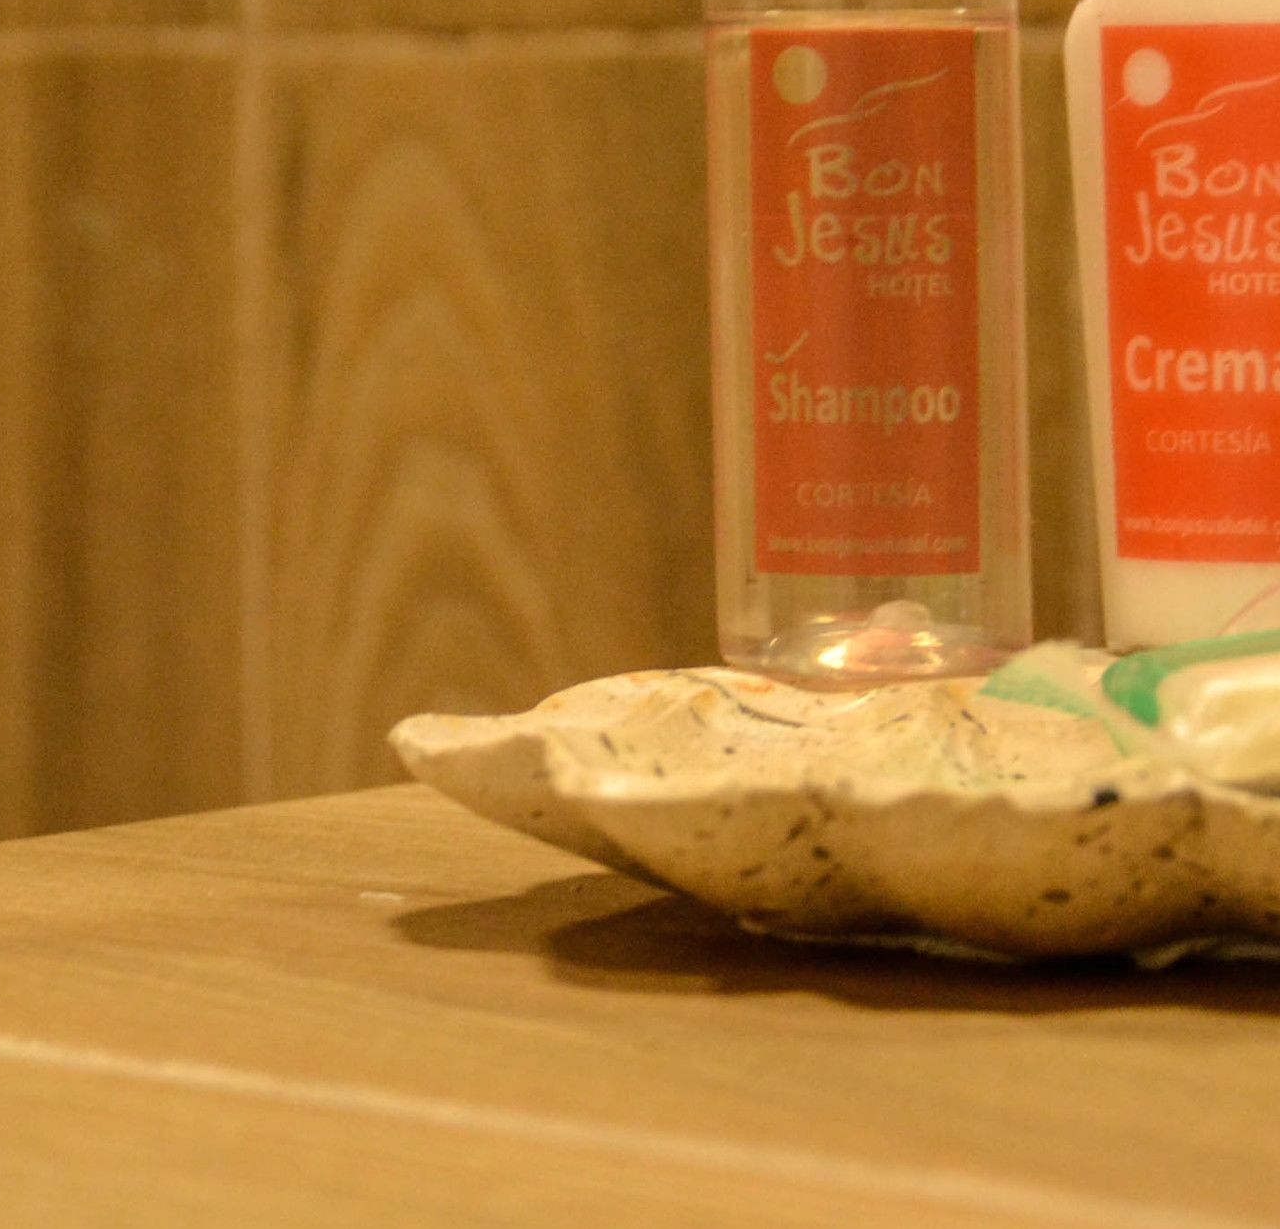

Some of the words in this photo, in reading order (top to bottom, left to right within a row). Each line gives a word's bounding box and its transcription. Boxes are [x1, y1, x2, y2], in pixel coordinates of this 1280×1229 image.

[868, 273, 954, 296] HOTEL
[769, 370, 961, 435] Shampoo
[1145, 426, 1272, 454] CORTESÍA
[795, 477, 933, 508] CORTESÍA
